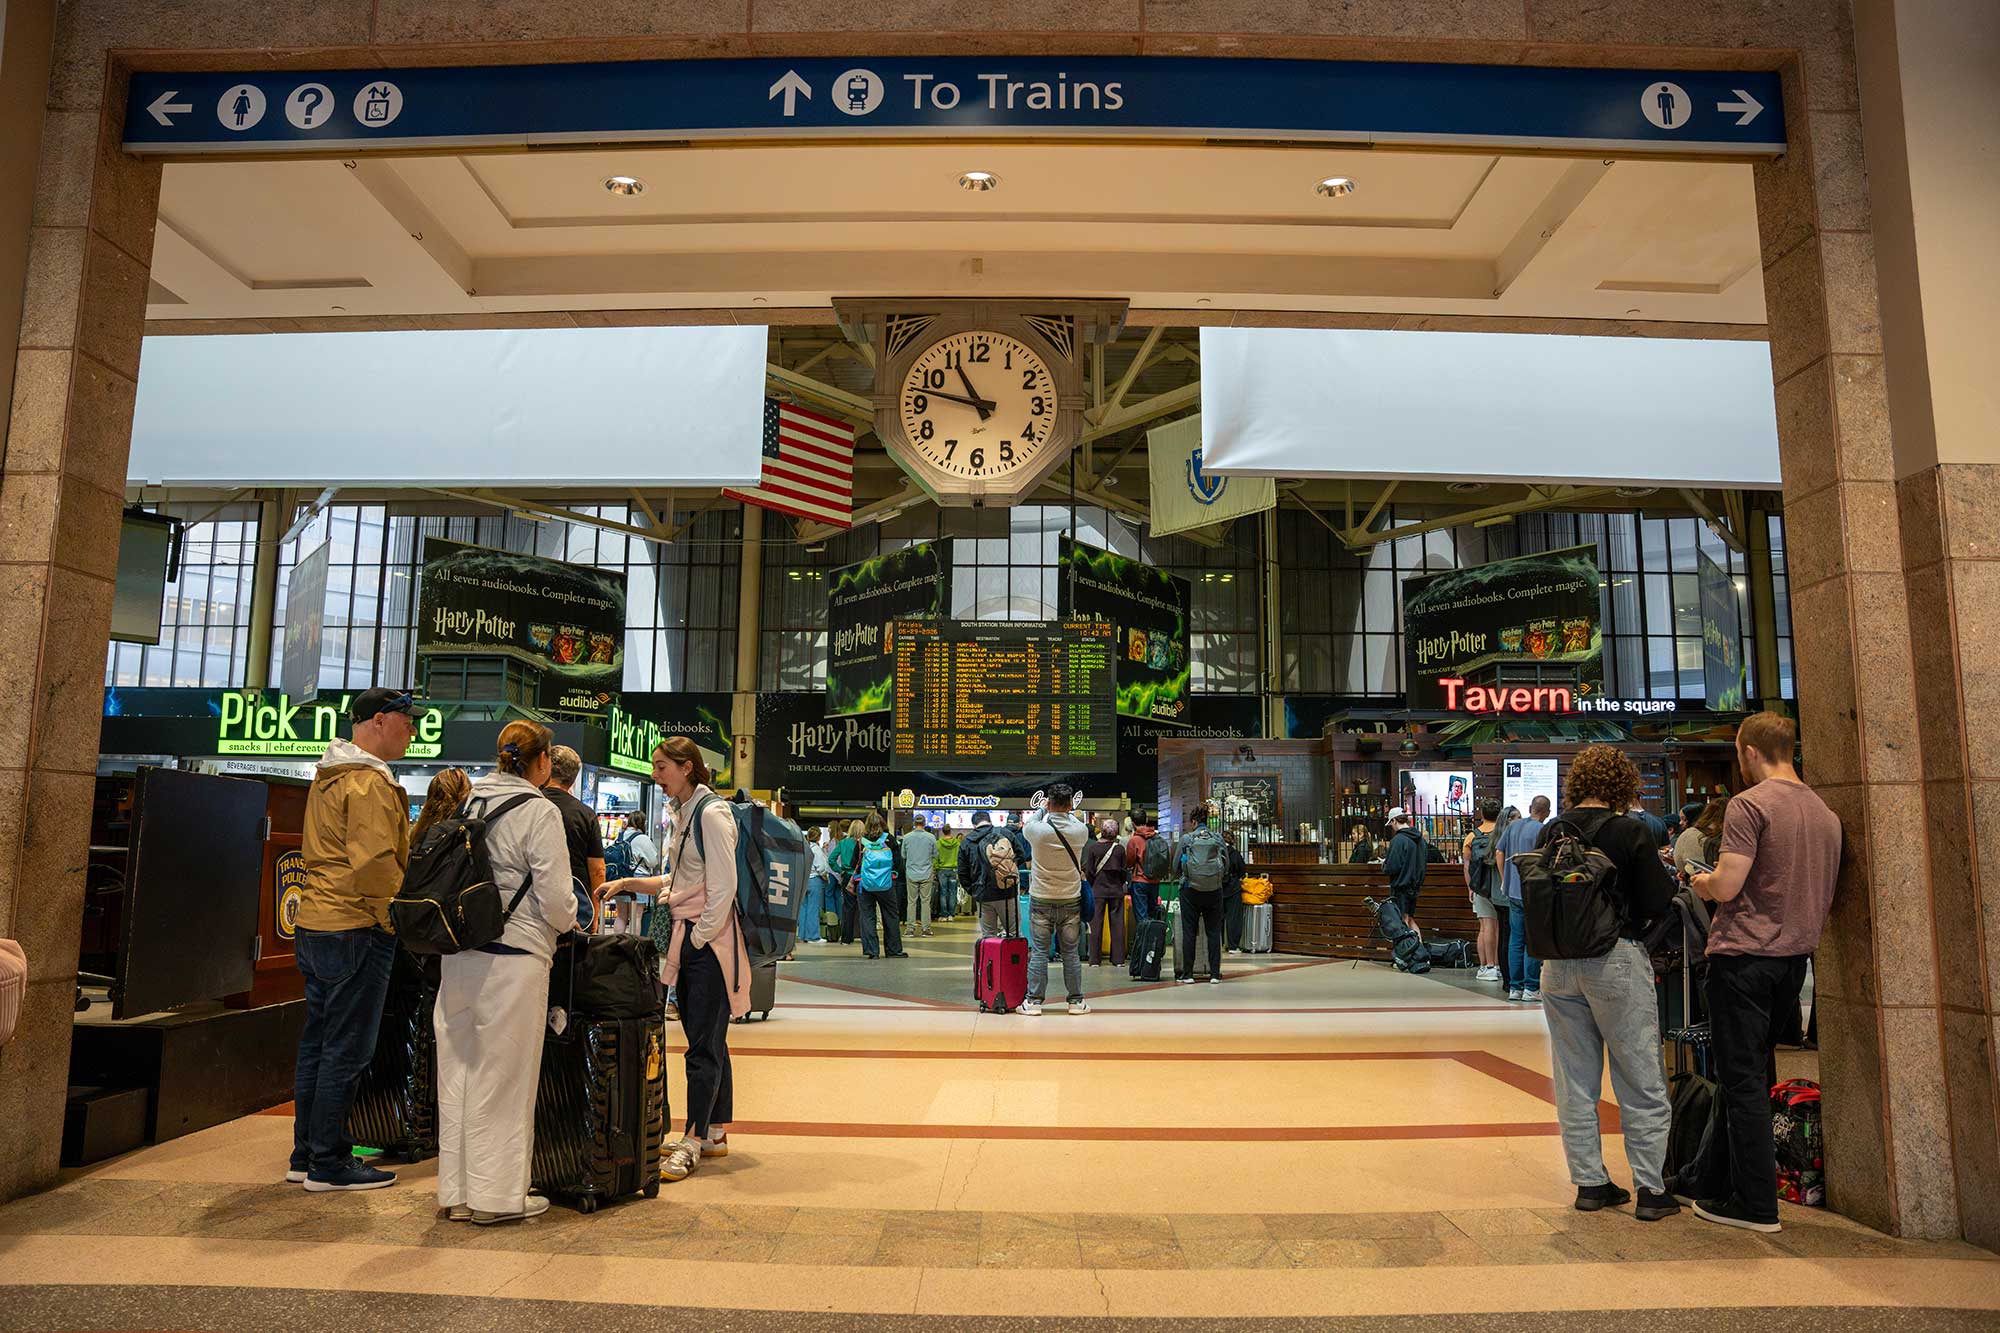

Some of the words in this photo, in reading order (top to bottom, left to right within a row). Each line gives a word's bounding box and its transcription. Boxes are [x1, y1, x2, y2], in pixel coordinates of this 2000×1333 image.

[904, 74, 960, 110] To
[978, 72, 1124, 110] Trains
[945, 350, 962, 370] 11
[968, 343, 990, 362] 12
[1005, 350, 1012, 370] 1
[922, 369, 945, 389] 10
[1023, 370, 1037, 390] 2
[914, 395, 928, 414] 9
[1032, 396, 1045, 416] 3
[920, 420, 934, 440] 8
[1021, 422, 1035, 441] 4
[945, 440, 958, 460] 7
[970, 448, 984, 468] 6
[1000, 440, 1013, 462] 5
[434, 568, 451, 582] All
[453, 573, 480, 586] seven
[482, 577, 539, 597] audiobooks.
[542, 586, 585, 605] Complete
[587, 596, 616, 610] magic.
[834, 594, 843, 606] All
[844, 594, 857, 605] seven
[859, 585, 893, 601] audiobooks.
[893, 576, 923, 592] Complete
[1078, 575, 1097, 588] seven
[1098, 579, 1136, 600] audiobooks.
[1137, 591, 1166, 610] Complete
[1413, 604, 1426, 615] All
[1428, 602, 1450, 613] seven
[1452, 592, 1505, 610] audiobooks.
[1507, 584, 1553, 600] Complete
[1555, 578, 1587, 593] magic.
[433, 606, 475, 636] Harry
[476, 608, 516, 642] Potter
[834, 629, 855, 657] Harry
[856, 622, 879, 654] Potter
[1416, 636, 1450, 664] Harry
[1451, 630, 1486, 665] Potter
[560, 695, 599, 710] audible
[1439, 678, 1570, 712] Tavern
[1578, 698, 1591, 711] in
[1595, 698, 1622, 711] the
[1624, 700, 1675, 715] square
[220, 692, 300, 740] Pick
[314, 695, 350, 740] n'
[1152, 703, 1177, 718] audible
[611, 707, 635, 756] Pick
[636, 720, 648, 759] n'
[660, 721, 713, 733] diobooks.
[1124, 726, 1140, 737] All
[1144, 728, 1174, 737] seven
[1176, 726, 1244, 737] audiobooks.
[228, 742, 260, 752] snacks
[274, 742, 295, 752] chef
[296, 743, 329, 753] create
[406, 745, 432, 755] alads
[787, 721, 842, 758] Harry
[845, 719, 891, 760] Potte
[227, 762, 256, 772] BEVERAGES
[260, 767, 289, 776] SANDWICHES
[280, 857, 309, 873] TRANSI
[282, 872, 307, 887] POLICE
[769, 862, 789, 906] HH
